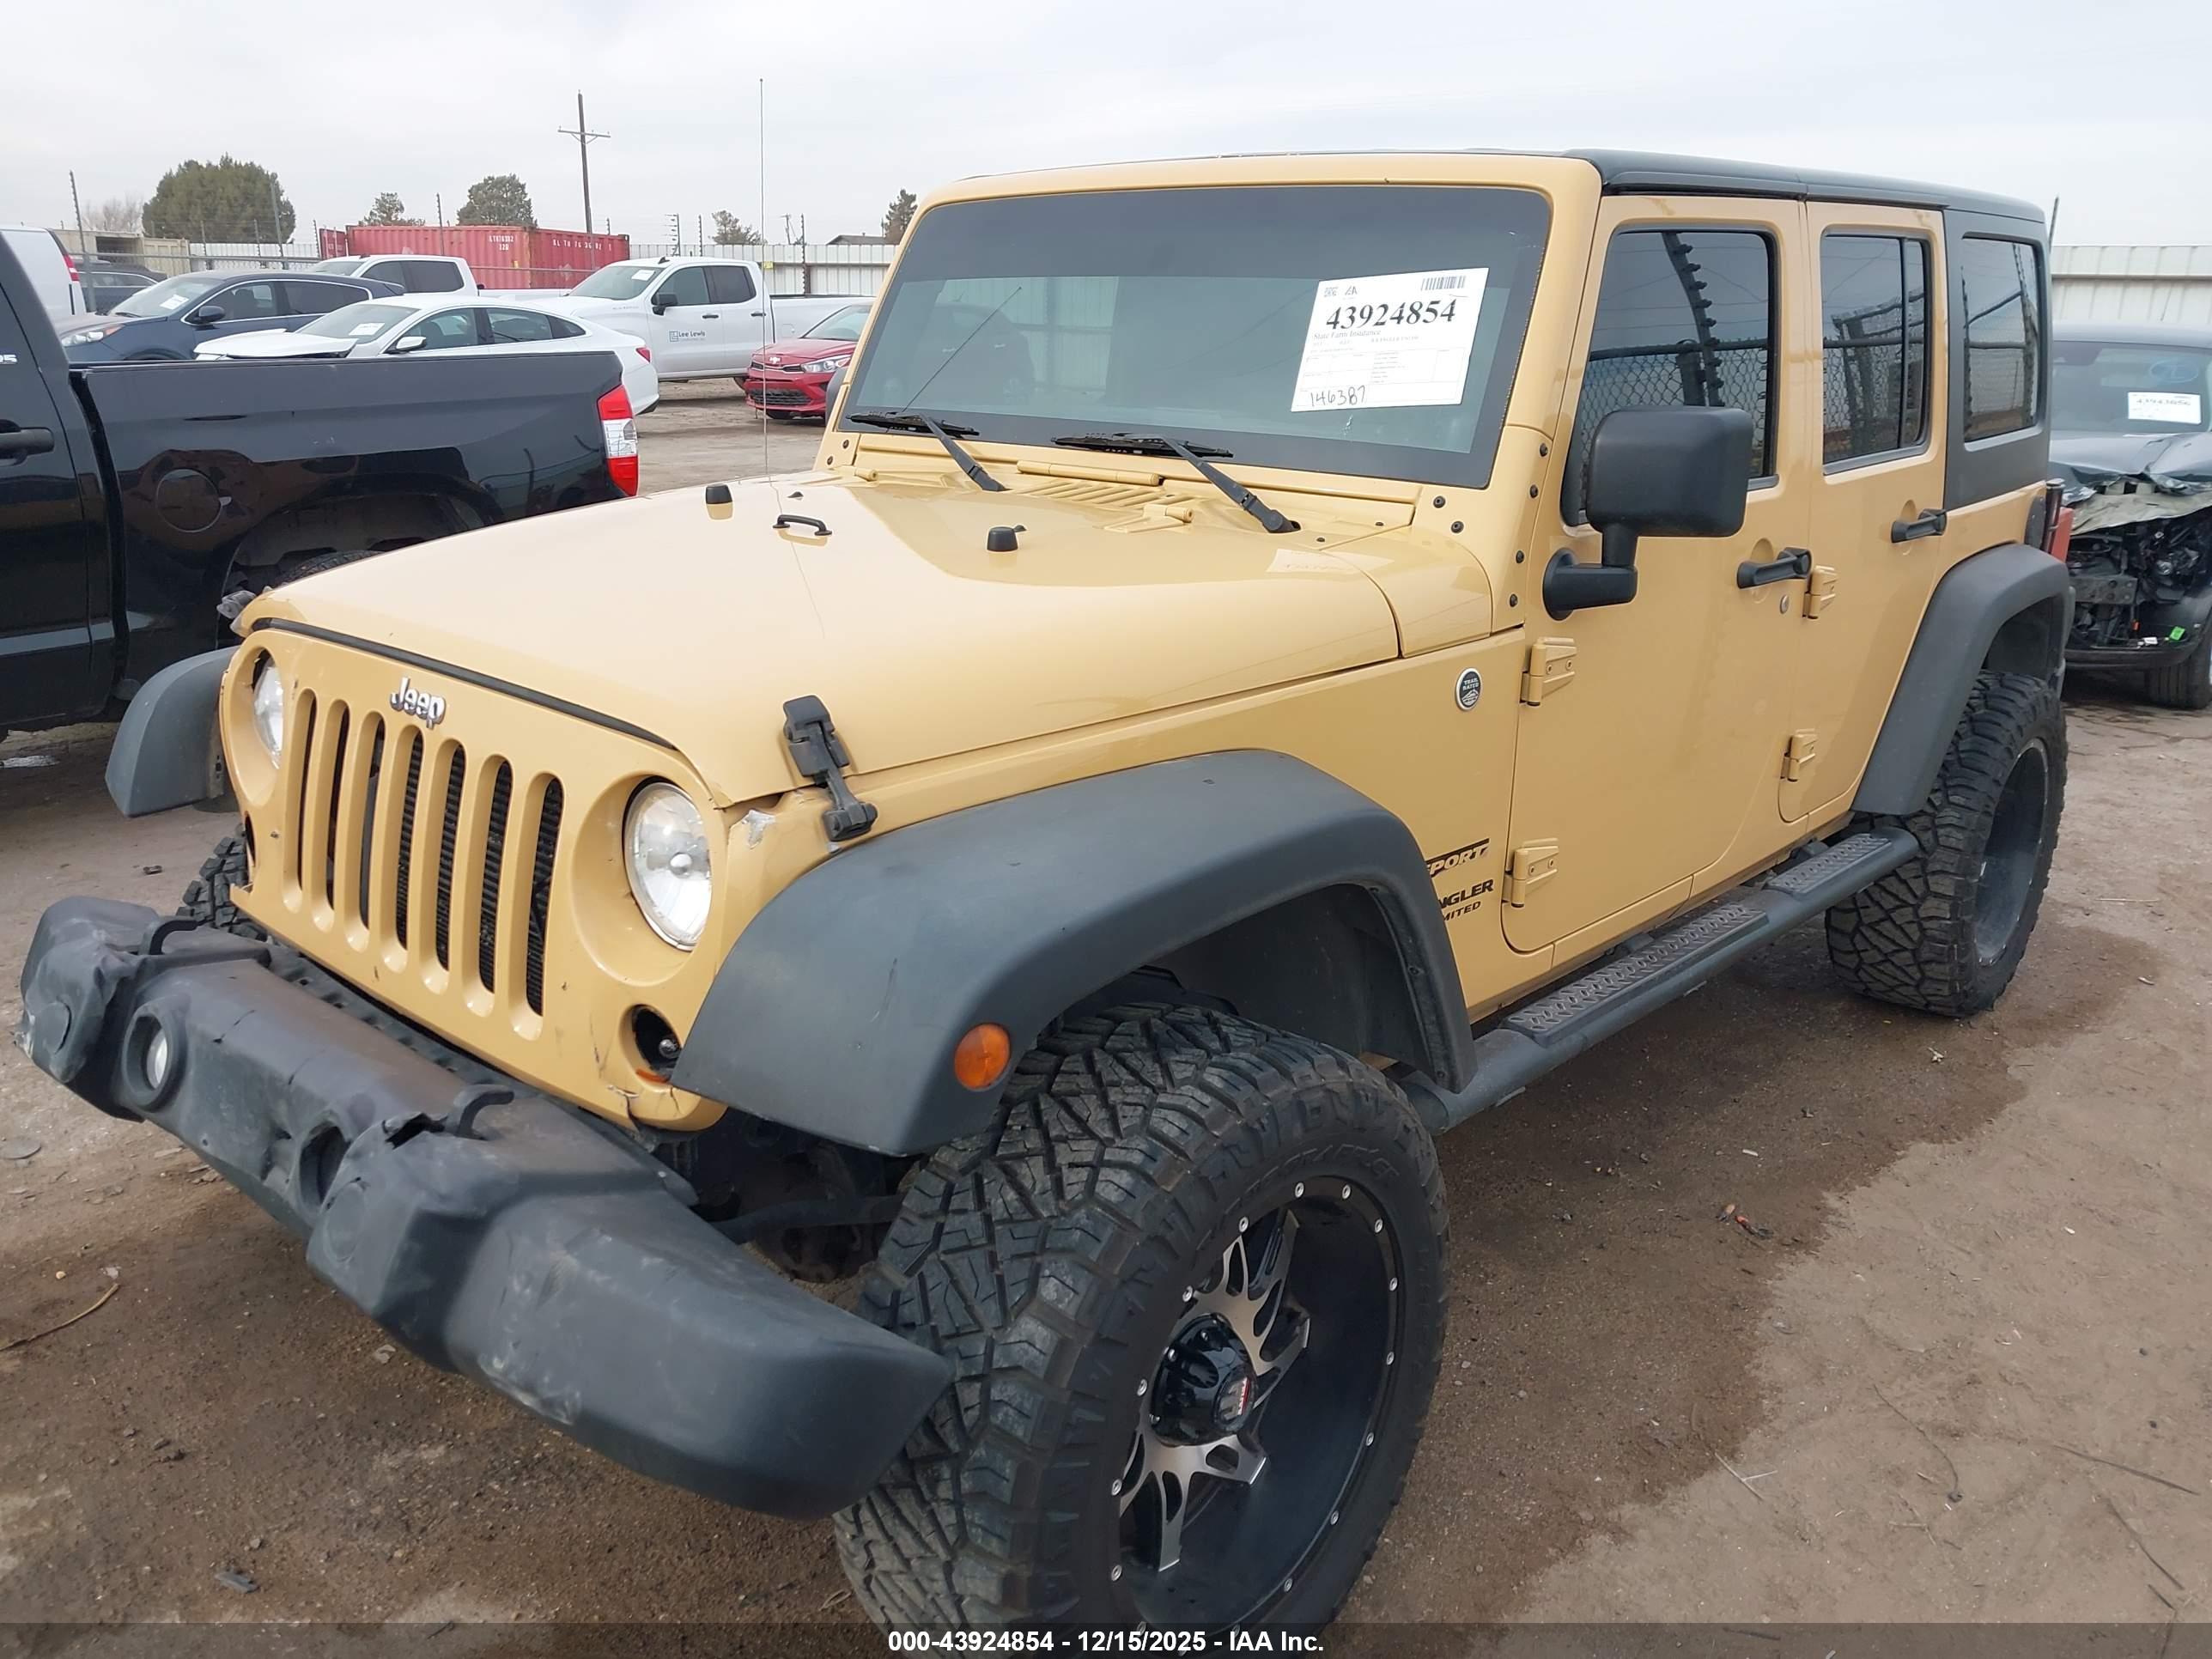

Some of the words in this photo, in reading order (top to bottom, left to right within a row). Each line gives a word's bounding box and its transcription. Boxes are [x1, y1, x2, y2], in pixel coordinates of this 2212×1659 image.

[1326, 299, 1457, 330] 43924854
[1331, 331, 1348, 339] Farm
[1310, 385, 1366, 407] 146387
[1462, 683, 1480, 691] RATED
[1463, 678, 1479, 686] TRAIL
[391, 677, 447, 730] Jeep
[1426, 842, 1489, 878] PORT
